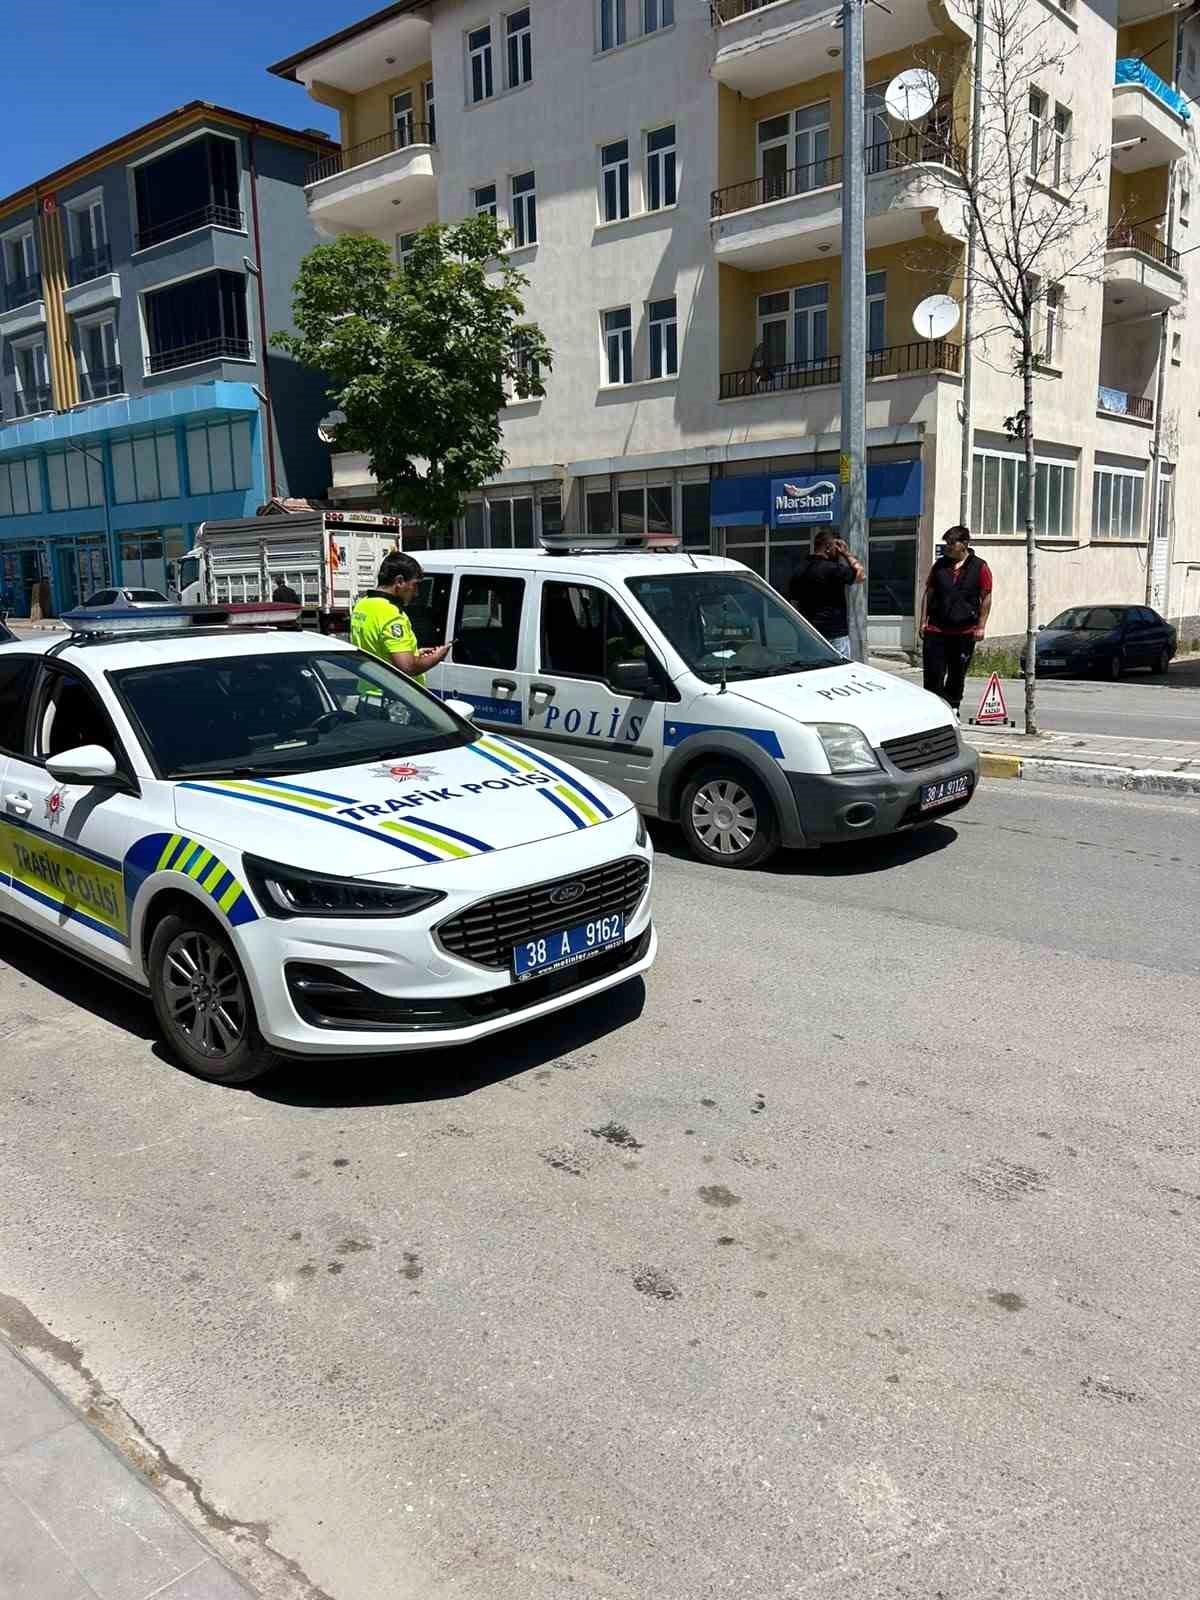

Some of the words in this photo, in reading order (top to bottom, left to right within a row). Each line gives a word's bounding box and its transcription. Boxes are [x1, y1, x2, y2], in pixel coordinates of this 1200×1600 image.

[775, 493, 829, 510] Marshall
[543, 706, 645, 742] POLİS
[336, 788, 463, 821] TRAFİK
[460, 769, 559, 794] POLİSİ
[926, 786, 937, 802] 38
[938, 783, 944, 798] A
[13, 842, 66, 891] TRAFİK
[64, 866, 120, 918] POLİSİ
[526, 939, 547, 967] 38
[561, 930, 571, 955] A
[586, 914, 620, 946] 9162
